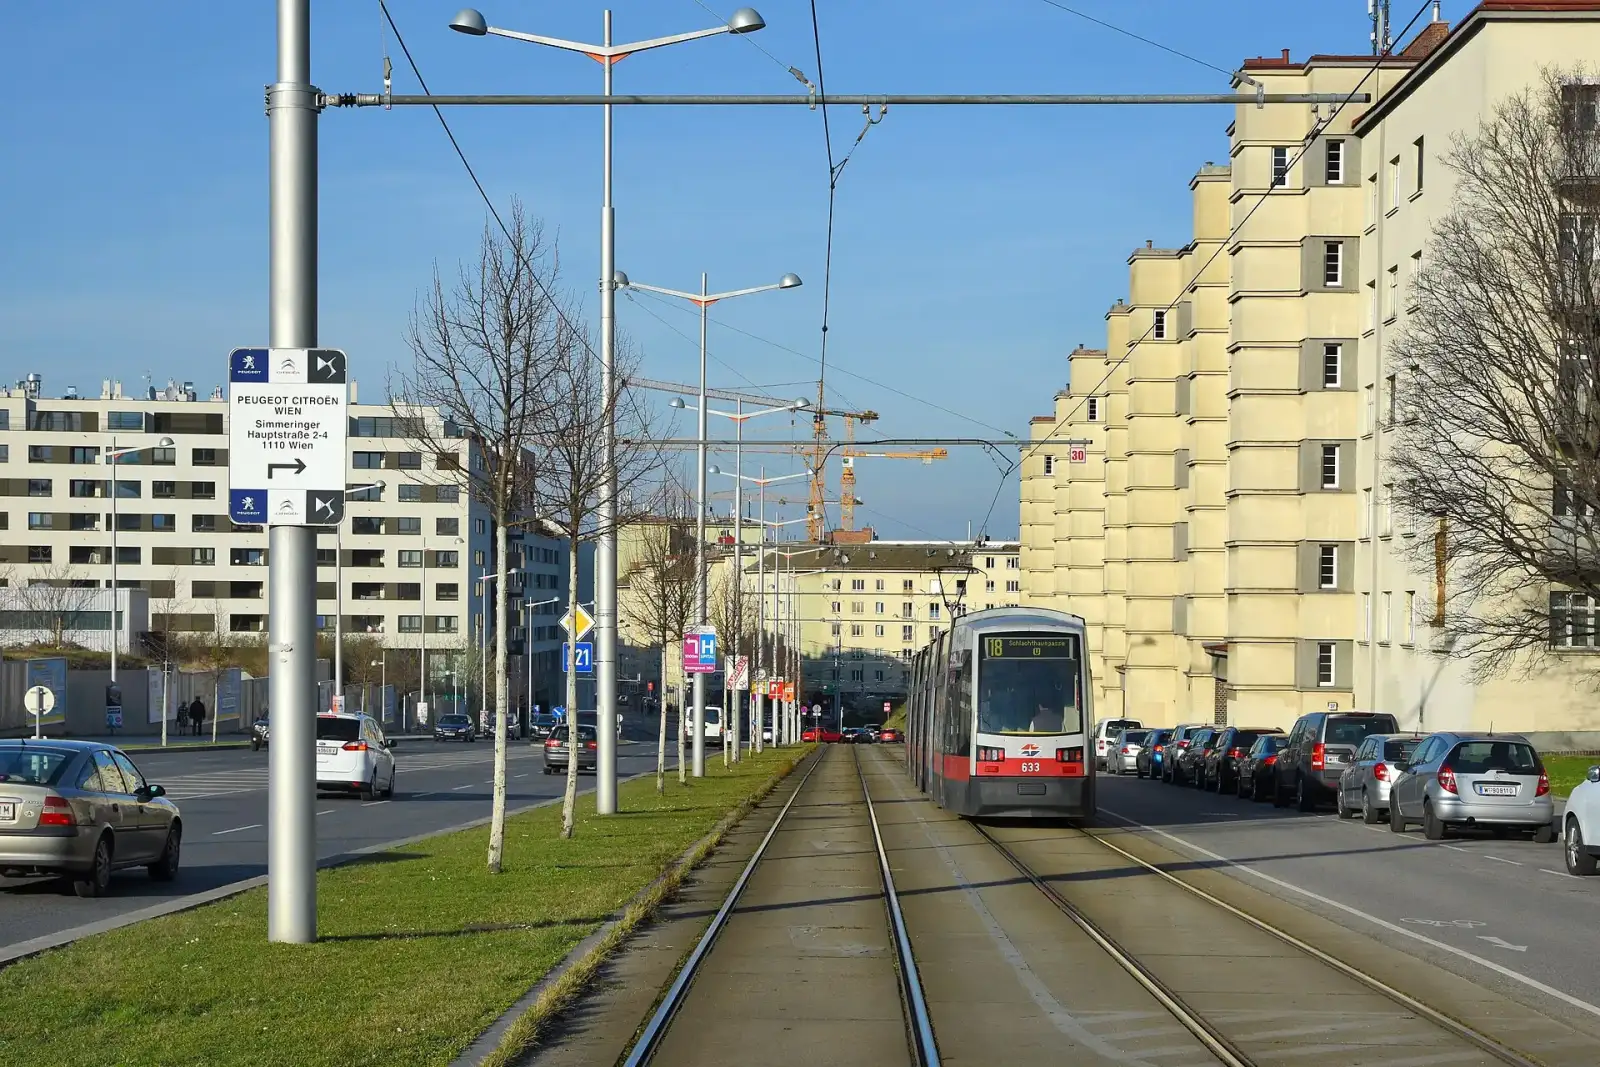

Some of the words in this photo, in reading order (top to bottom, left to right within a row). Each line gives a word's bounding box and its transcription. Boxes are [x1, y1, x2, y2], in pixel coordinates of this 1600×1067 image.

[237, 395, 288, 405] PEUGEOT
[291, 395, 339, 405] CITROËN
[274, 407, 302, 415] WIEN
[255, 419, 321, 431] Simmeringer
[247, 430, 310, 442] Hauptstraße
[312, 431, 328, 440] 2-4
[262, 441, 286, 450] 1110
[288, 441, 314, 450] Wien
[1072, 450, 1083, 460] 30
[701, 640, 714, 654] H
[989, 639, 1003, 657] 18
[567, 648, 589, 666] 21
[1021, 762, 1040, 772] 633
